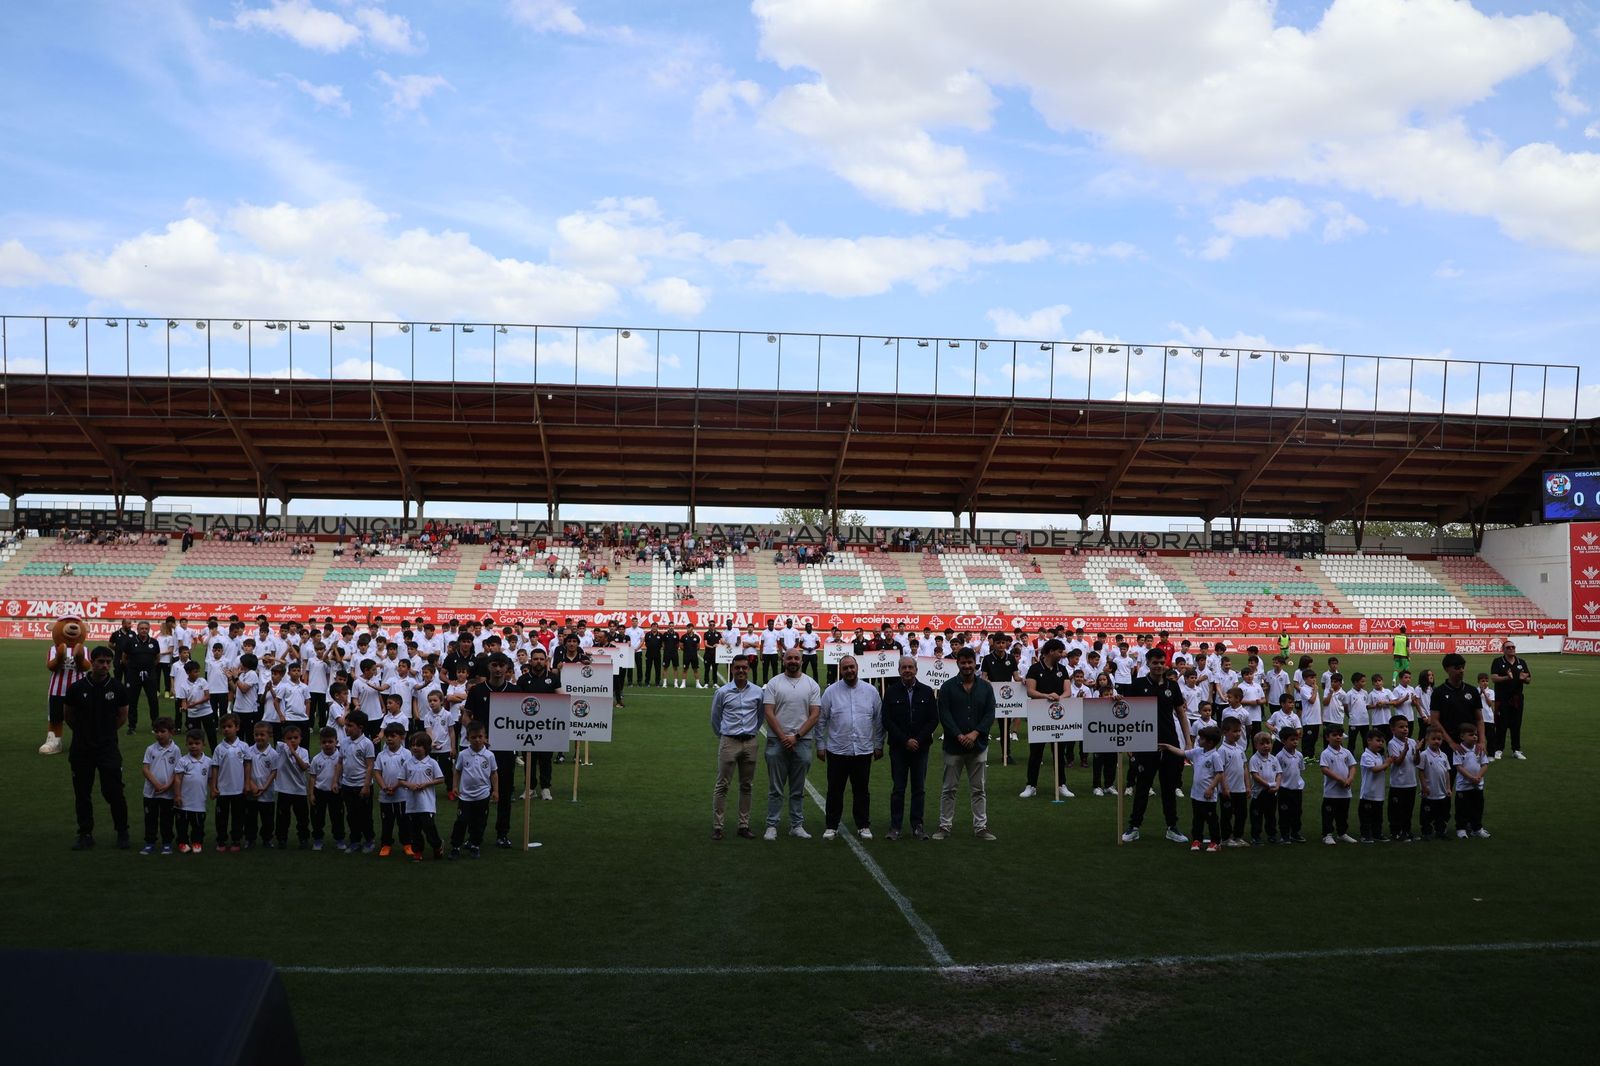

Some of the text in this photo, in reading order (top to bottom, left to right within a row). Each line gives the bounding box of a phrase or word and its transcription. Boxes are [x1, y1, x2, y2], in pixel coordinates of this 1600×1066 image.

[1574, 492, 1585, 506] 0
[155, 514, 281, 532] ESTADIO
[1031, 529, 1070, 547] DE
[1077, 531, 1202, 549] ZAMORA
[26, 600, 108, 617] ZAMORA CF
[648, 611, 759, 628] CAJA RURAL
[852, 615, 920, 624] recoletas salud
[1311, 622, 1353, 630] leomotor.net
[1371, 619, 1407, 629] ZAMORA
[1298, 639, 1330, 653] Opinión
[1357, 639, 1389, 654] Opinión
[1414, 639, 1445, 653] Opinión
[1564, 638, 1594, 652] ZAMORA
[926, 670, 950, 678] Alevín
[566, 685, 608, 694] Benjamín
[494, 717, 566, 732] Chupetín
[1032, 723, 1083, 732] PREBENJAMÍN
[1088, 720, 1153, 735] Chupetín
